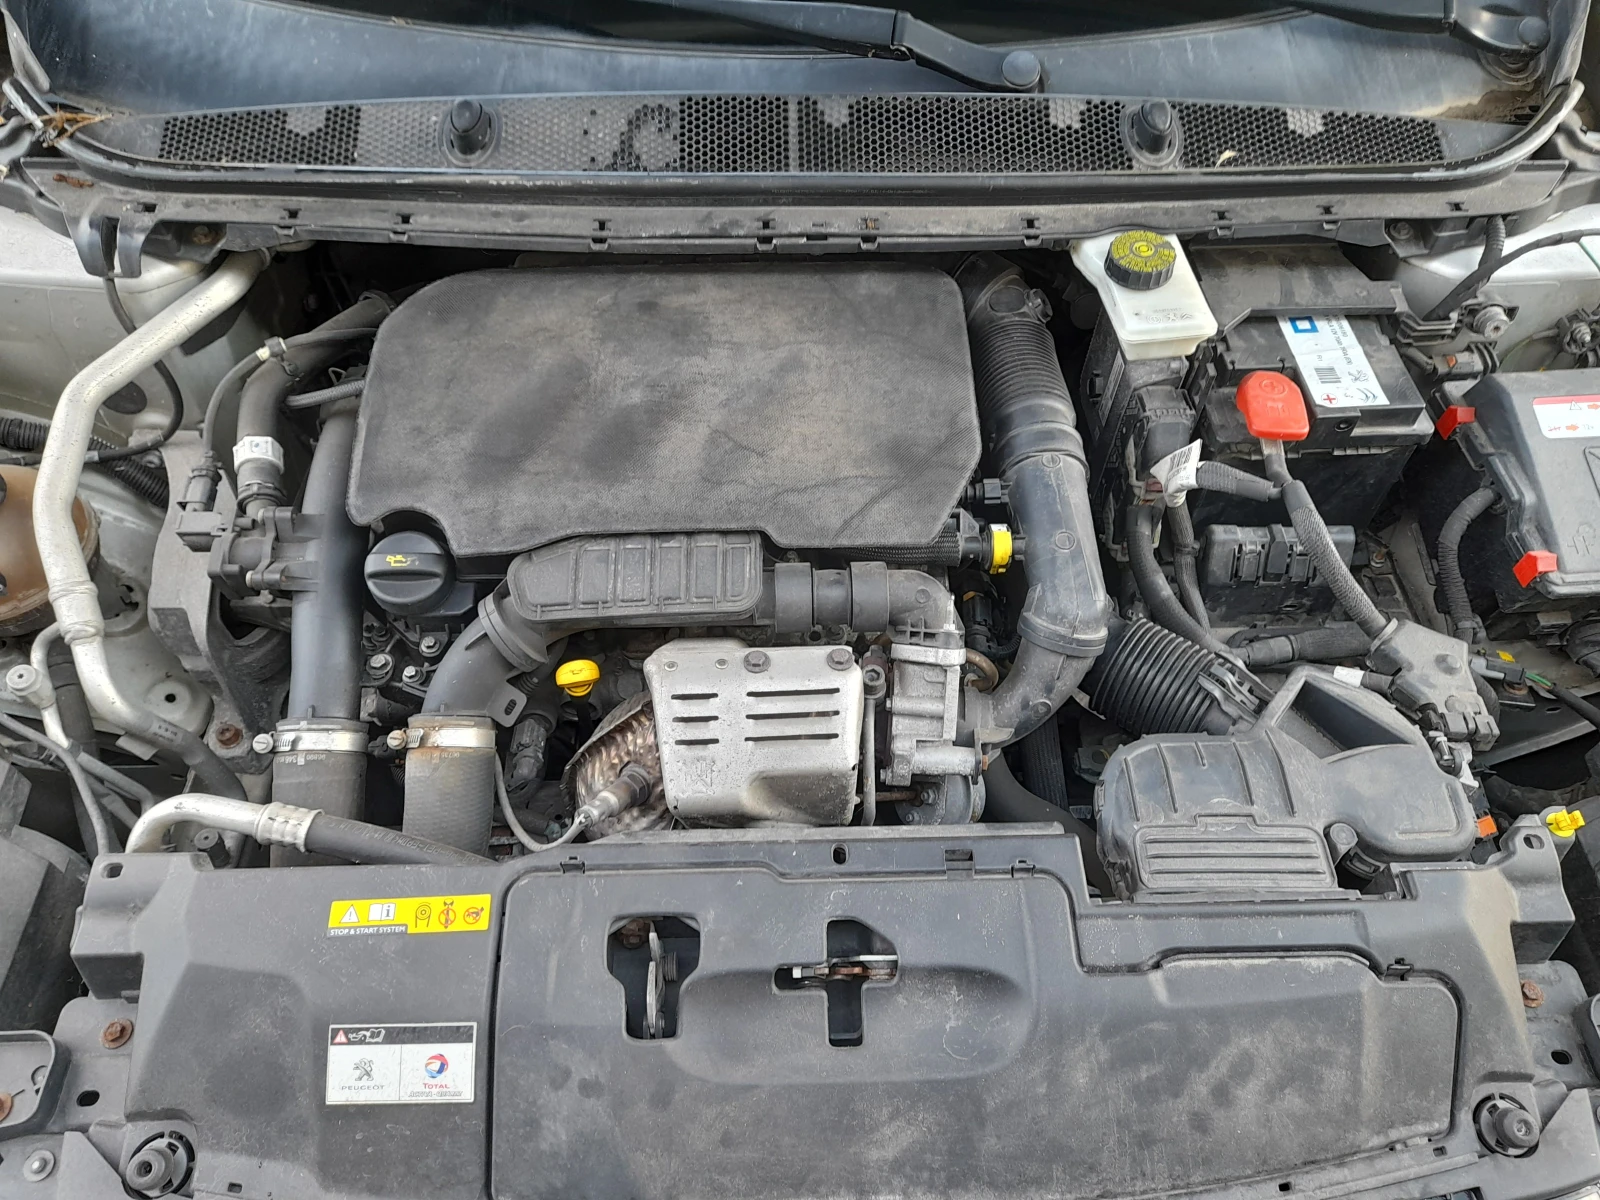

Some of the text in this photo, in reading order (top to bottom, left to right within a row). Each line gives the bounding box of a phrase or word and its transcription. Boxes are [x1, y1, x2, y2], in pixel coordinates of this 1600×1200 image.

[330, 928, 349, 936] STOP
[356, 926, 377, 935] START
[378, 925, 406, 934] SYSTEM
[422, 1082, 450, 1090] TOTAL
